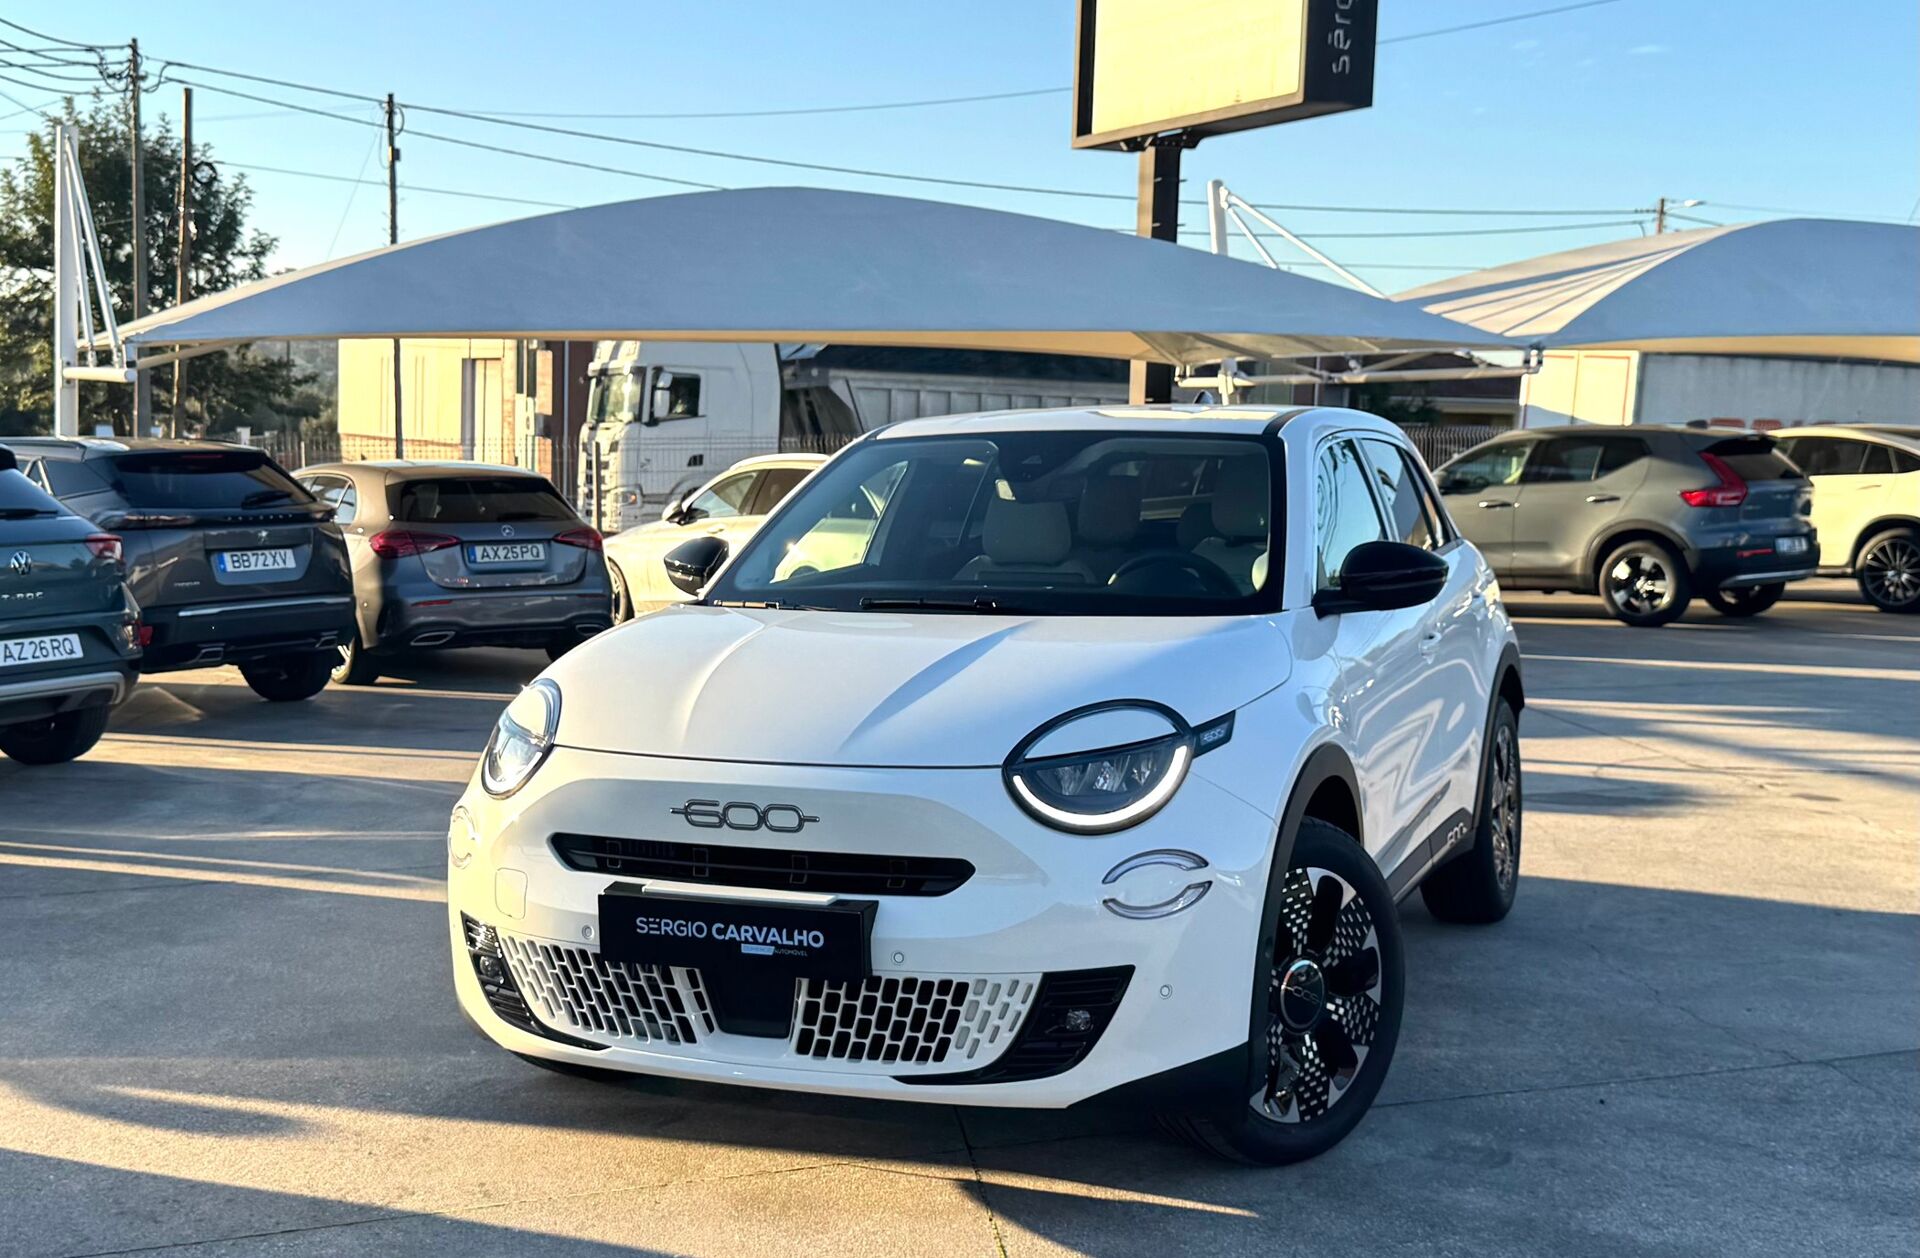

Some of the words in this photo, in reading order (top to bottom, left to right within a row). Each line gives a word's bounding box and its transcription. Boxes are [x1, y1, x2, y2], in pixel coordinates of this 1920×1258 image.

[231, 551, 288, 569] BB72XV
[481, 544, 541, 561] AX25PQ
[3, 637, 77, 663] AZ26RQ
[684, 799, 805, 834] 600
[712, 923, 825, 948] CARVALHO
